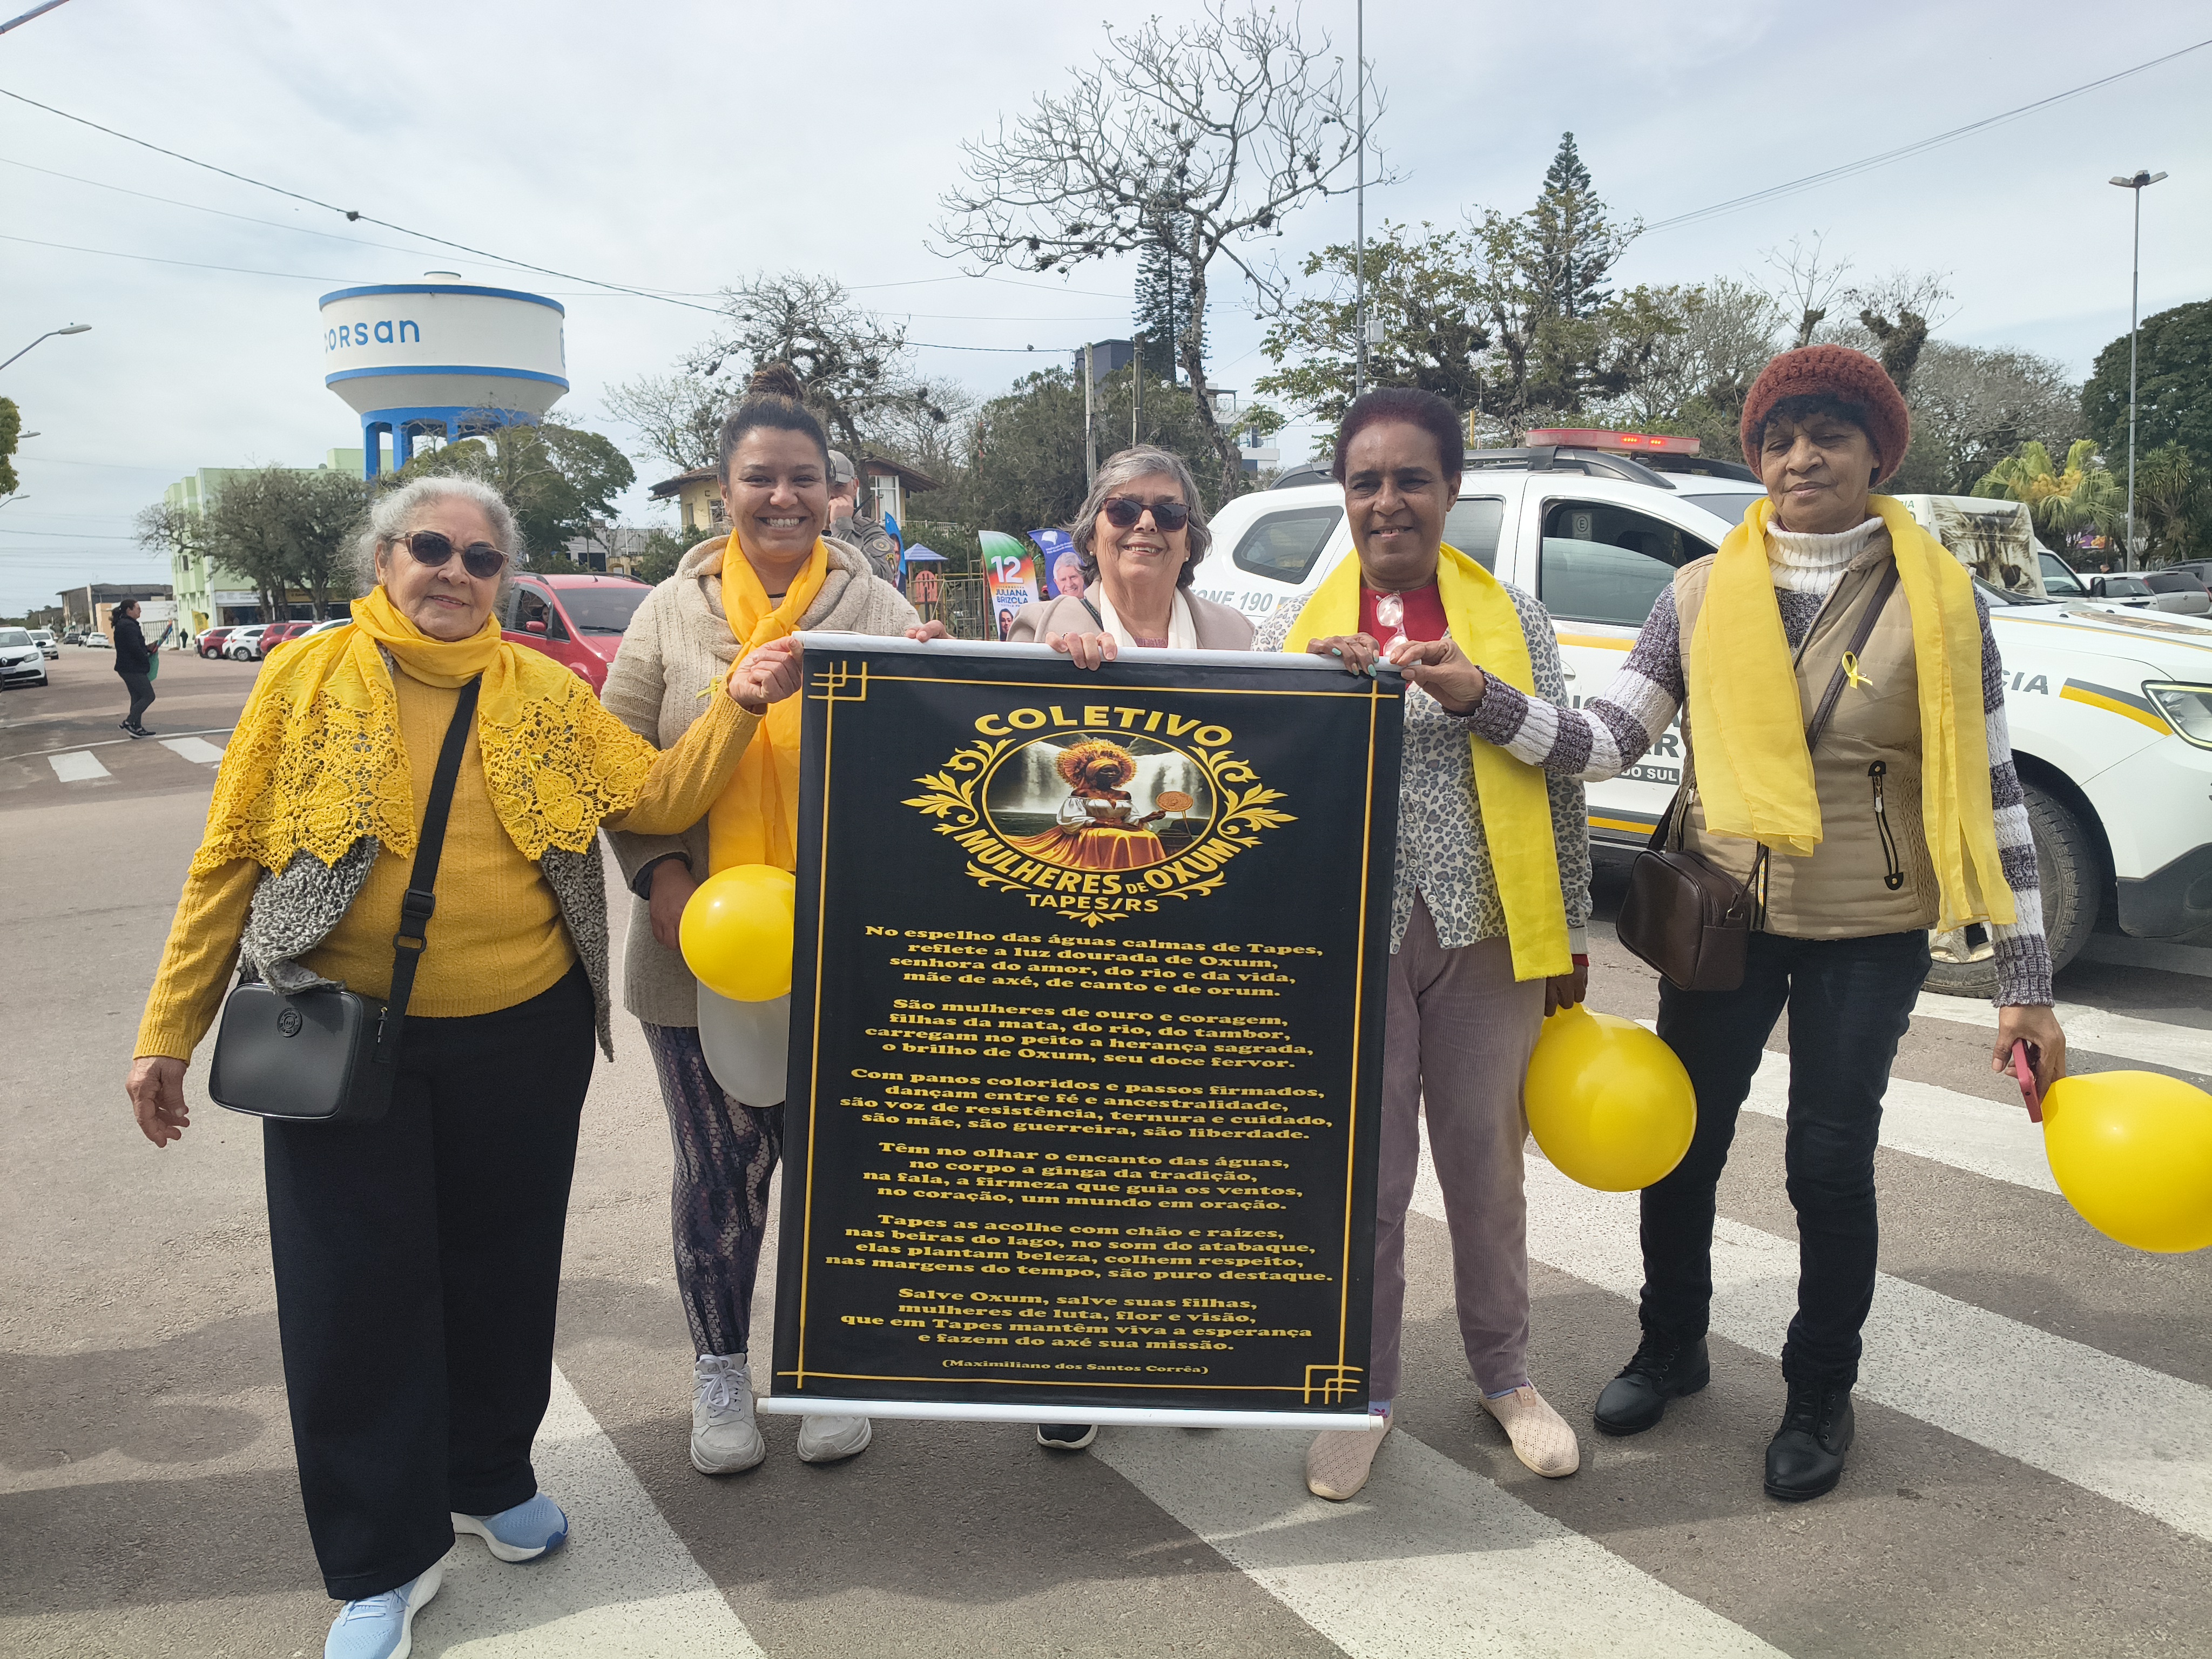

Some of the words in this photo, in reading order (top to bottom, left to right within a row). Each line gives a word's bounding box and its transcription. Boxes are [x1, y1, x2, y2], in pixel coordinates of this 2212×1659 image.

[990, 555, 1024, 583] 12
[995, 588, 1028, 597] JULIANA
[1240, 592, 1273, 612] 190
[974, 705, 1232, 747] COLETIVO
[1647, 768, 1677, 782] SUL
[954, 827, 1120, 895] MULHERES
[1125, 880, 1149, 895] DE
[1147, 837, 1242, 890] OXUM
[1026, 893, 1159, 912] TAPES/RS
[865, 926, 899, 936] No
[904, 930, 996, 941] espelho
[1002, 933, 1042, 943] das
[1048, 934, 1116, 947] águas
[1122, 939, 1206, 951] calmas
[1212, 942, 1241, 953] de
[1246, 943, 1324, 956] Tapes,
[907, 943, 989, 955] reflete
[1014, 947, 1051, 959] luz
[1057, 949, 1159, 963] dourada
[1164, 955, 1193, 965] de
[1199, 956, 1279, 970] Oxum,
[889, 957, 986, 970] senhora
[991, 961, 1022, 971] do
[1027, 964, 1098, 976] amor,
[1104, 966, 1135, 976] do
[1140, 968, 1177, 979] rio
[1182, 972, 1196, 980] e
[1201, 970, 1231, 981] da
[1236, 972, 1296, 984] vida,
[903, 972, 953, 982] mãe
[958, 974, 986, 984] de
[992, 976, 1040, 988] axé,
[1045, 977, 1075, 988] de
[1080, 981, 1148, 992] canto
[1154, 984, 1168, 993] e
[1172, 984, 1202, 994] de
[1207, 987, 1280, 996] orum.
[893, 999, 936, 1010] São
[941, 1003, 1056, 1016] mulheres
[1061, 1007, 1090, 1017] de
[1095, 1010, 1154, 1021] ouro
[1159, 1014, 1173, 1022] e
[1178, 1015, 1289, 1027] coragem,
[865, 1028, 979, 1042] carregam
[984, 1034, 1015, 1043] no
[1020, 1035, 1084, 1046] peito
[1089, 1039, 1103, 1047] a
[1109, 1038, 1208, 1053] herança
[1213, 1044, 1314, 1056] sagrada,
[901, 1042, 977, 1056] brilho
[983, 1047, 1012, 1057] de
[1017, 1048, 1097, 1063] Oxum,
[1103, 1054, 1144, 1064] seu
[1150, 1055, 1206, 1066] doce
[1211, 1057, 1296, 1068] fervor.
[851, 1068, 904, 1081] Com
[909, 1074, 981, 1085] panos
[986, 1077, 1100, 1090] coloridos
[1105, 1083, 1119, 1091] e
[1124, 1084, 1204, 1095] passos
[1209, 1085, 1325, 1099] firmados,
[840, 1096, 879, 1108] são
[884, 1101, 926, 1111] voz
[931, 1102, 960, 1112] de
[965, 1105, 1104, 1122] resistência,
[1109, 1111, 1206, 1123] ternura
[1211, 1116, 1225, 1124] e
[1230, 1115, 1333, 1128] cuidado,
[861, 1112, 900, 1123] são
[906, 1116, 962, 1129] mãe,
[967, 1118, 1007, 1129] são
[1013, 1122, 1137, 1137] guerreira,
[1143, 1126, 1183, 1137] são
[1188, 1128, 1310, 1139] liberdade.
[878, 1142, 930, 1155] Têm
[936, 1148, 967, 1156] no
[973, 1148, 1040, 1159] olhar
[1065, 1154, 1163, 1165] encanto
[1168, 1156, 1209, 1166] das
[1215, 1156, 1290, 1169] águas,
[862, 1172, 892, 1181] na
[897, 1172, 950, 1186] fala,
[975, 1177, 1069, 1190] firmeza
[1075, 1183, 1121, 1193] que
[1126, 1184, 1178, 1195] guia
[1184, 1186, 1210, 1195] os
[1216, 1186, 1303, 1197] ventos,
[877, 1188, 908, 1196] no
[913, 1190, 1014, 1204] coração,
[1021, 1195, 1060, 1204] um
[1065, 1197, 1152, 1208] mundo
[1158, 1201, 1194, 1209] em
[1199, 1199, 1287, 1211] oração.
[877, 1214, 947, 1228] Tapes
[953, 1221, 979, 1229] as
[984, 1222, 1063, 1233] acolhe
[1069, 1226, 1120, 1235] com
[1125, 1226, 1183, 1237] chão
[1206, 1228, 1285, 1240] raízes,
[845, 1229, 885, 1238] nas
[891, 1230, 965, 1243] beiras
[971, 1235, 1002, 1244] do
[1007, 1236, 1065, 1249] lago,
[1071, 1240, 1102, 1249] no
[1108, 1242, 1157, 1251] som
[1163, 1241, 1193, 1251] do
[1198, 1242, 1316, 1255] atabaque,
[825, 1257, 866, 1266] nas
[871, 1259, 975, 1273] margens
[980, 1264, 1011, 1274] do
[1016, 1265, 1102, 1279] tempo,
[1108, 1268, 1148, 1279] são
[1153, 1271, 1212, 1280] puro
[1218, 1270, 1333, 1283] destaque.
[898, 1288, 964, 1300] Salve
[969, 1291, 1049, 1306] Oxum,
[1056, 1296, 1118, 1306] salve
[1123, 1299, 1176, 1307] suas
[1182, 1298, 1258, 1310] filhas,
[840, 1315, 885, 1325] que
[889, 1318, 926, 1327] em
[932, 1318, 1003, 1331] Tapes
[1009, 1323, 1109, 1334] mantêm
[1114, 1325, 1167, 1336] viva
[1192, 1328, 1313, 1338] esperança
[898, 1305, 1013, 1317] mulheres
[1018, 1308, 1047, 1318] de
[1053, 1309, 1110, 1321] luta,
[1116, 1311, 1163, 1321] flor
[1186, 1312, 1256, 1324] visão,
[936, 1333, 1009, 1345] fazem
[1015, 1336, 1046, 1346] do
[1051, 1337, 1092, 1347] axé
[1098, 1340, 1139, 1348] sua
[1145, 1340, 1234, 1350] missão.
[942, 1359, 1051, 1369] (Maximiliano
[1086, 1364, 1142, 1372] Santos
[1145, 1365, 1209, 1374] Corrêa)
